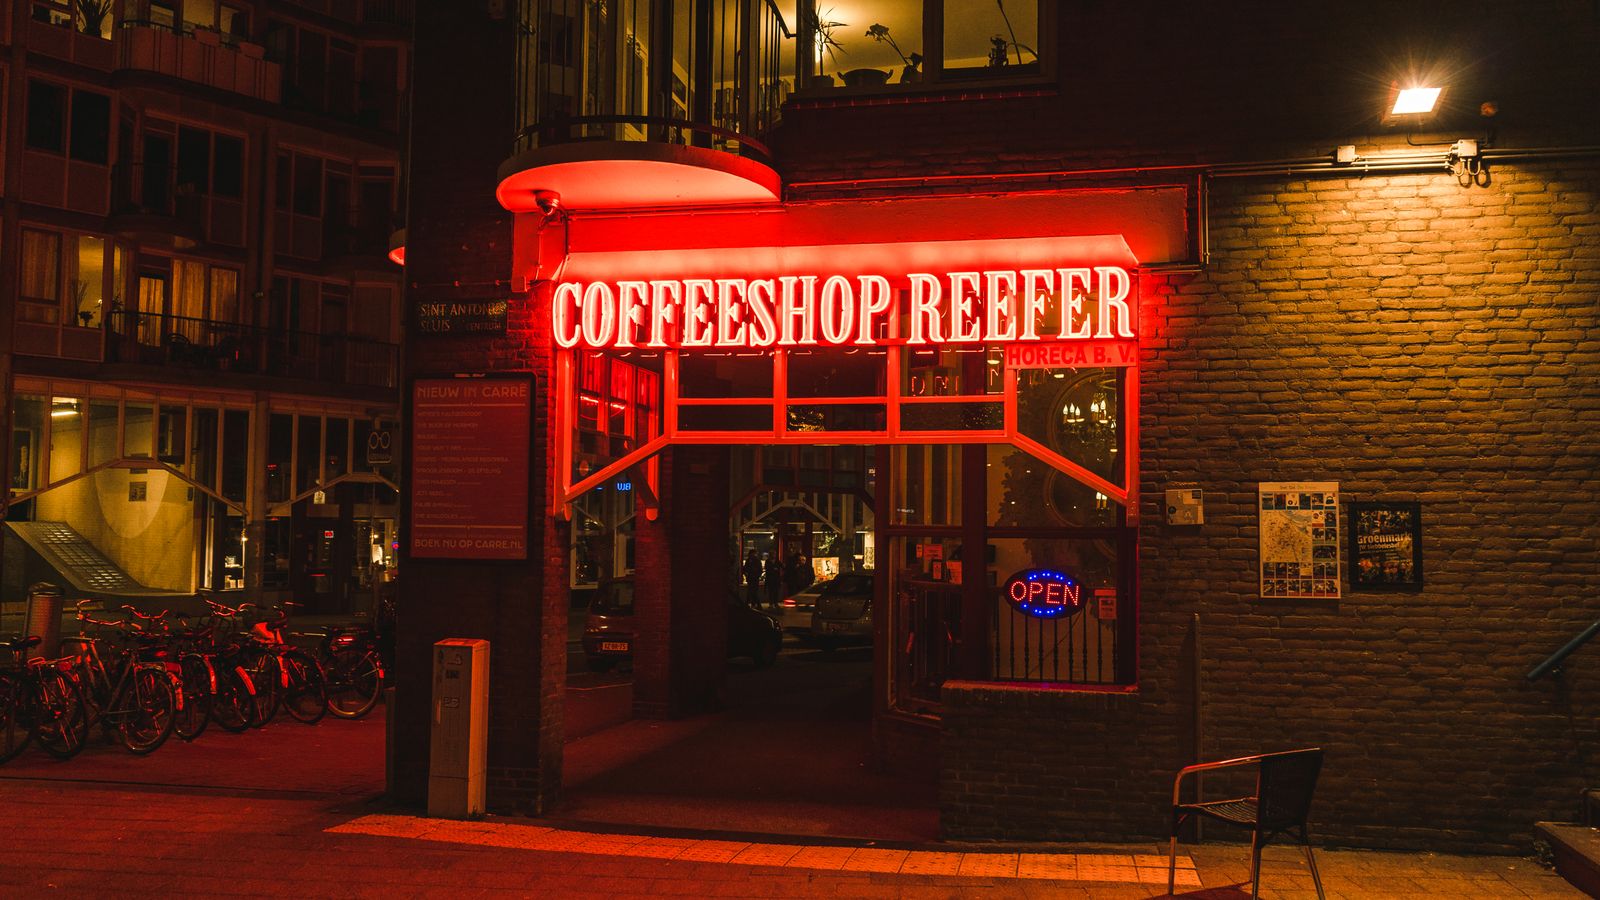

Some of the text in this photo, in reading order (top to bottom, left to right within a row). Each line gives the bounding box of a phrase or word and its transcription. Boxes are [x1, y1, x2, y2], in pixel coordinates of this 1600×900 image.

[419, 303, 447, 317] SINT
[552, 266, 1135, 349] COFFEESHOP REEFER
[1007, 344, 1136, 366] HORECA B. V.
[416, 386, 460, 399] NIEUW
[463, 386, 478, 398] IN
[415, 538, 441, 548] BOEK
[442, 539, 457, 549] NU
[458, 539, 473, 549] OP
[1011, 581, 1079, 606] OPEN
